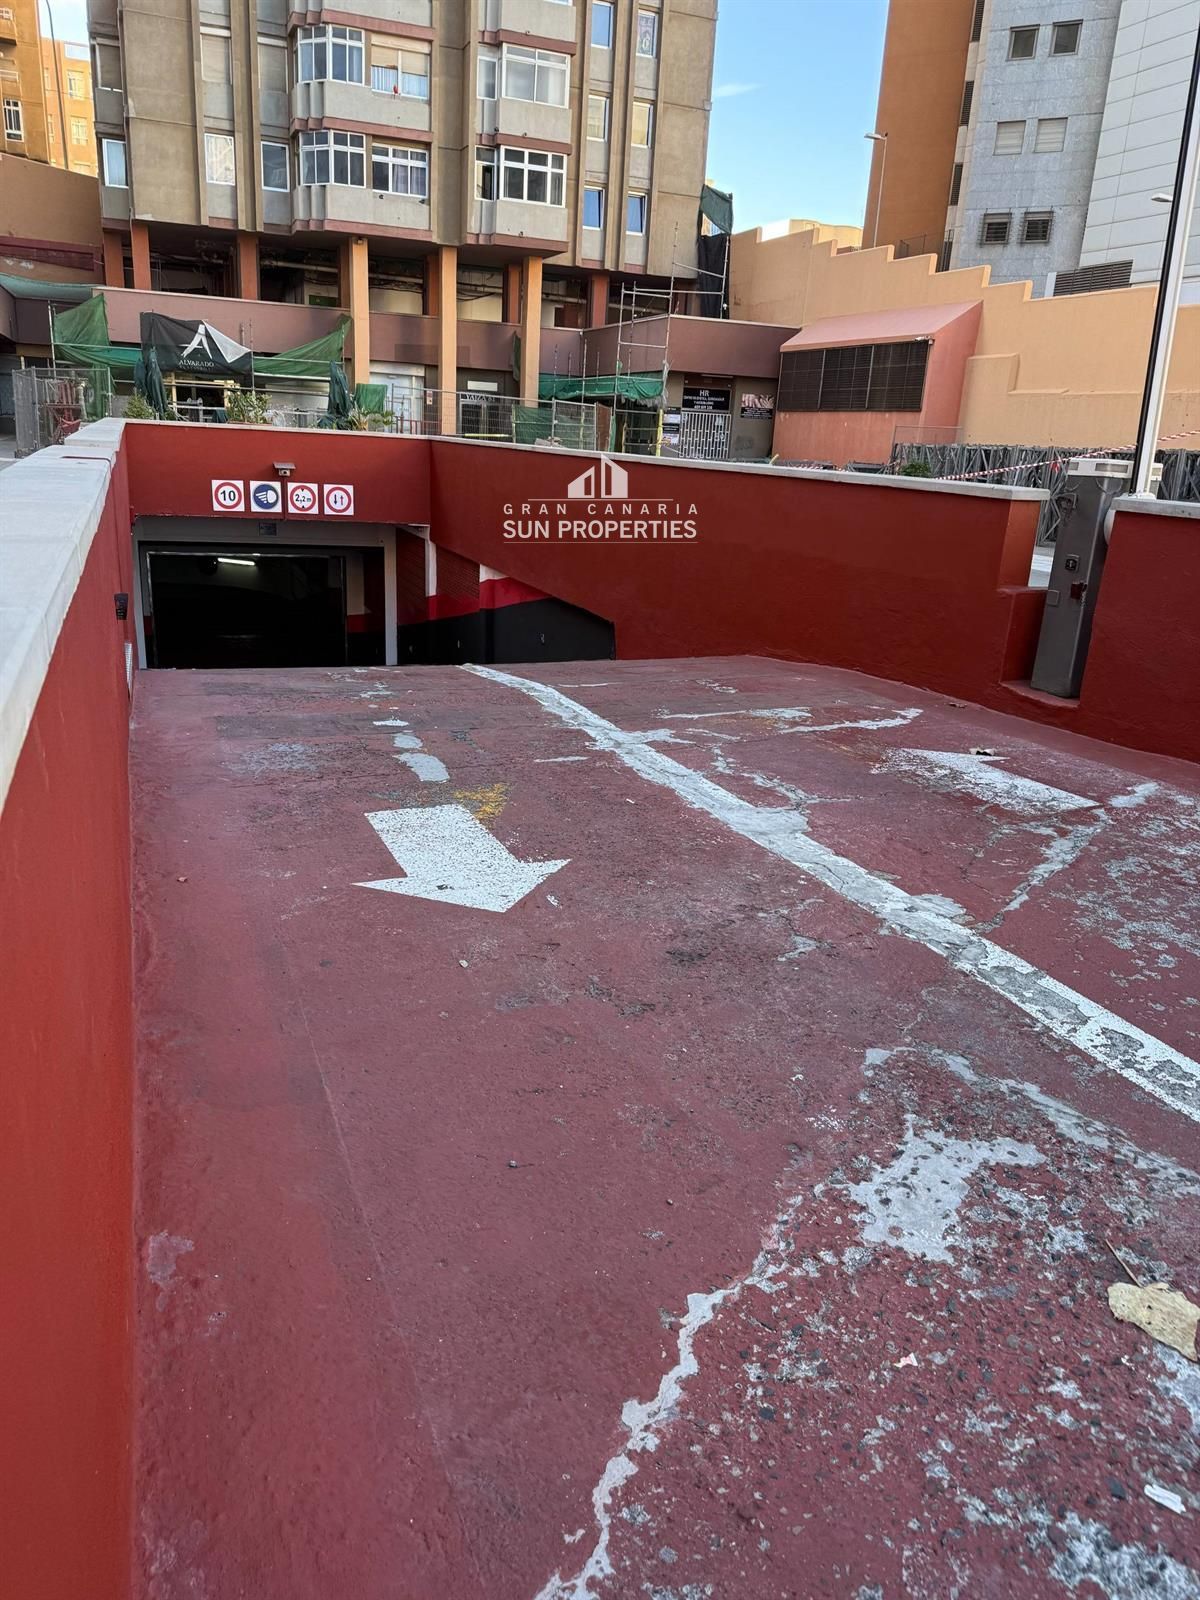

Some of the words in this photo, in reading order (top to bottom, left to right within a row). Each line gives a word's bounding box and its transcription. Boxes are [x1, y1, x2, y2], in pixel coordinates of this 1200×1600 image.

[178, 359, 215, 368] ALVARADO
[699, 389, 710, 397] HR
[220, 490, 236, 502] 10
